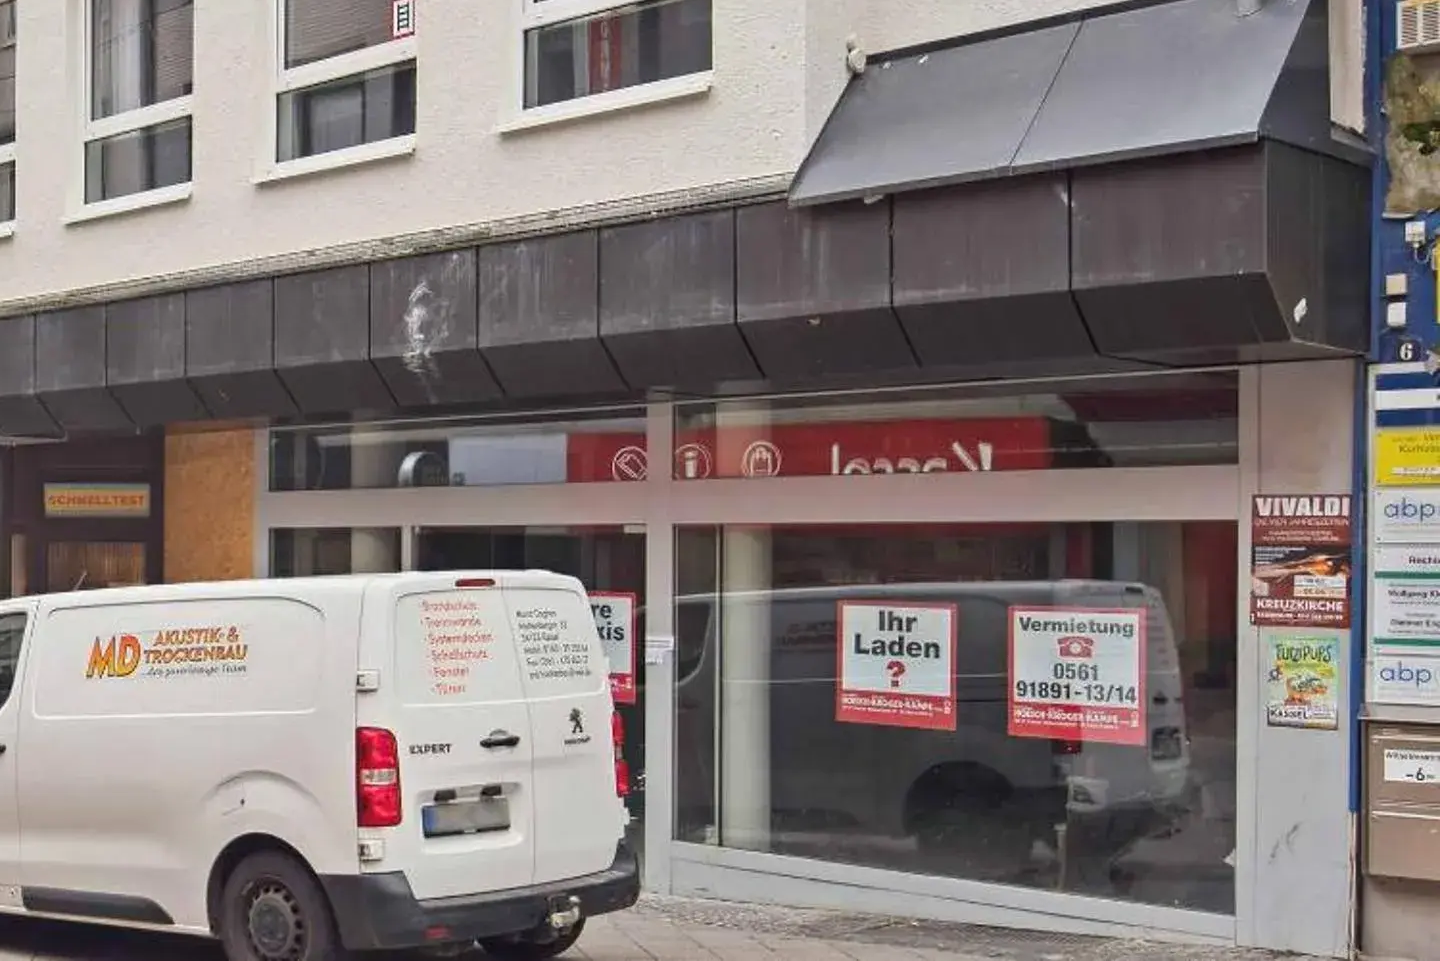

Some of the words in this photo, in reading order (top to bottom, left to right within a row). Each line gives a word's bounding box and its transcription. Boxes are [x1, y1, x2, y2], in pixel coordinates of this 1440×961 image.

[1399, 343, 1413, 361] 6
[1255, 497, 1350, 517] VIVALDI
[1384, 497, 1435, 521] abp
[1256, 599, 1345, 612] KREUZKIRCHE
[879, 610, 918, 632] Ihr
[1019, 617, 1134, 637] Vermietung
[227, 626, 239, 642] &
[143, 644, 248, 664] TROCKENBAU
[854, 633, 940, 659] Laden
[86, 634, 141, 679] MD
[887, 660, 906, 688] ?
[1053, 663, 1098, 680] 0561
[1380, 661, 1432, 687] abp
[1016, 680, 1137, 703] 91891-13/14
[409, 743, 452, 755] EXPERT
